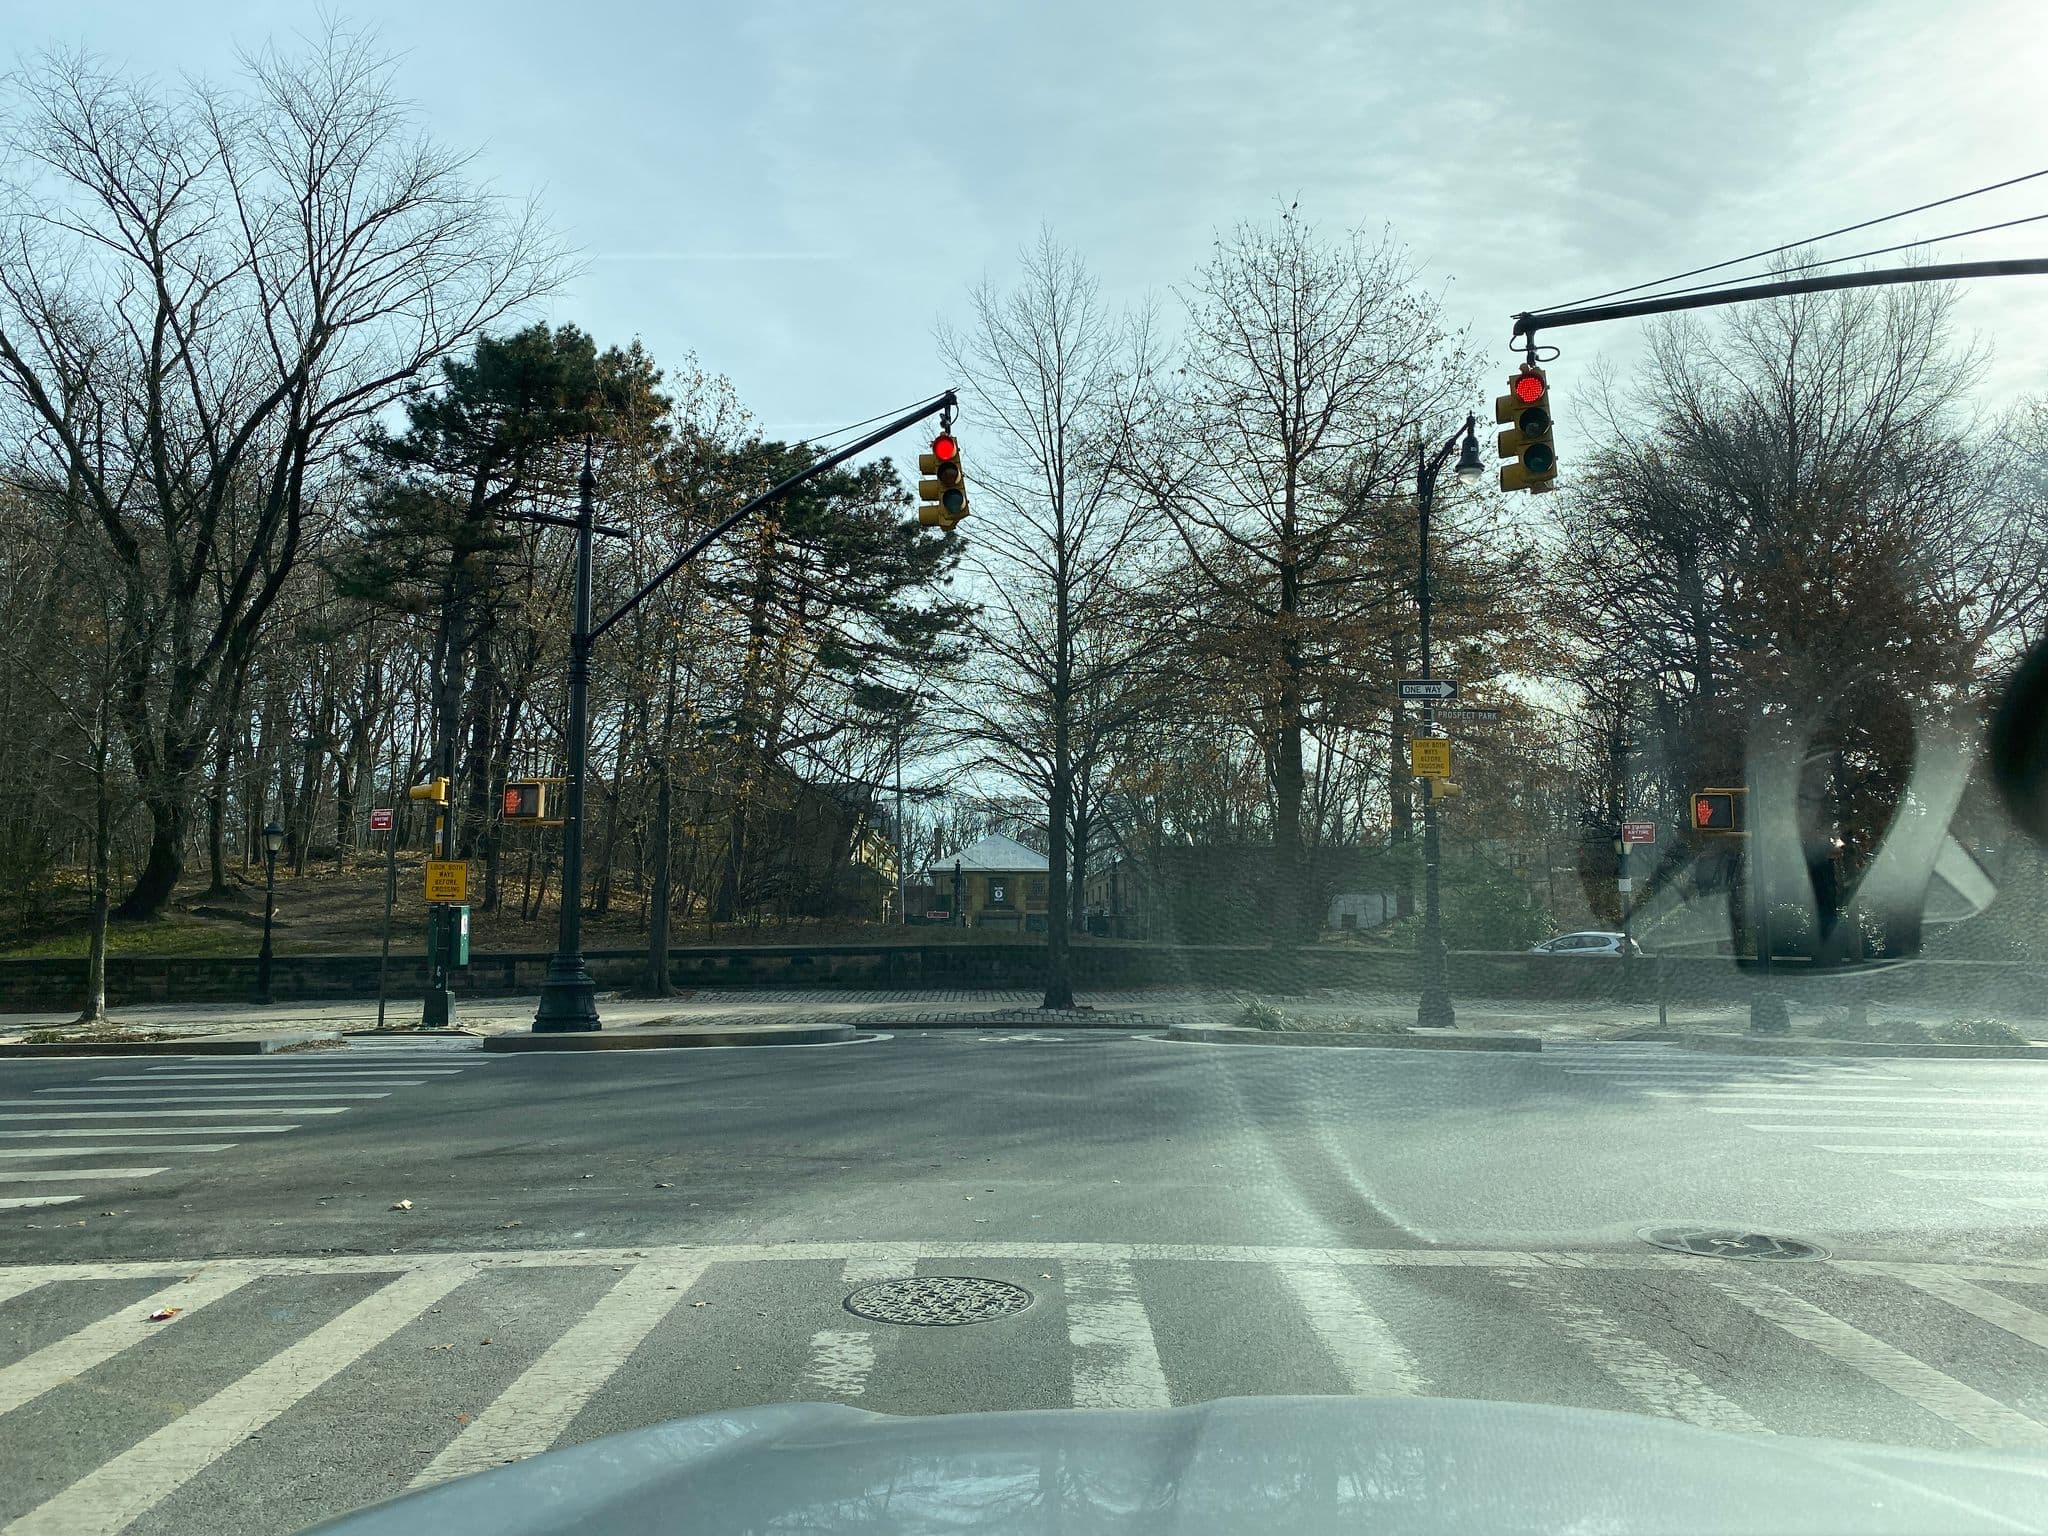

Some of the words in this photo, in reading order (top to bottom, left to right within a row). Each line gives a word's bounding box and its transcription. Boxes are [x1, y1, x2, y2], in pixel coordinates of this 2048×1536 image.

[1404, 685, 1421, 694] ONE
[1425, 685, 1442, 694] WAY
[1438, 710, 1475, 720] PROSPECT
[1478, 712, 1497, 721] PARK
